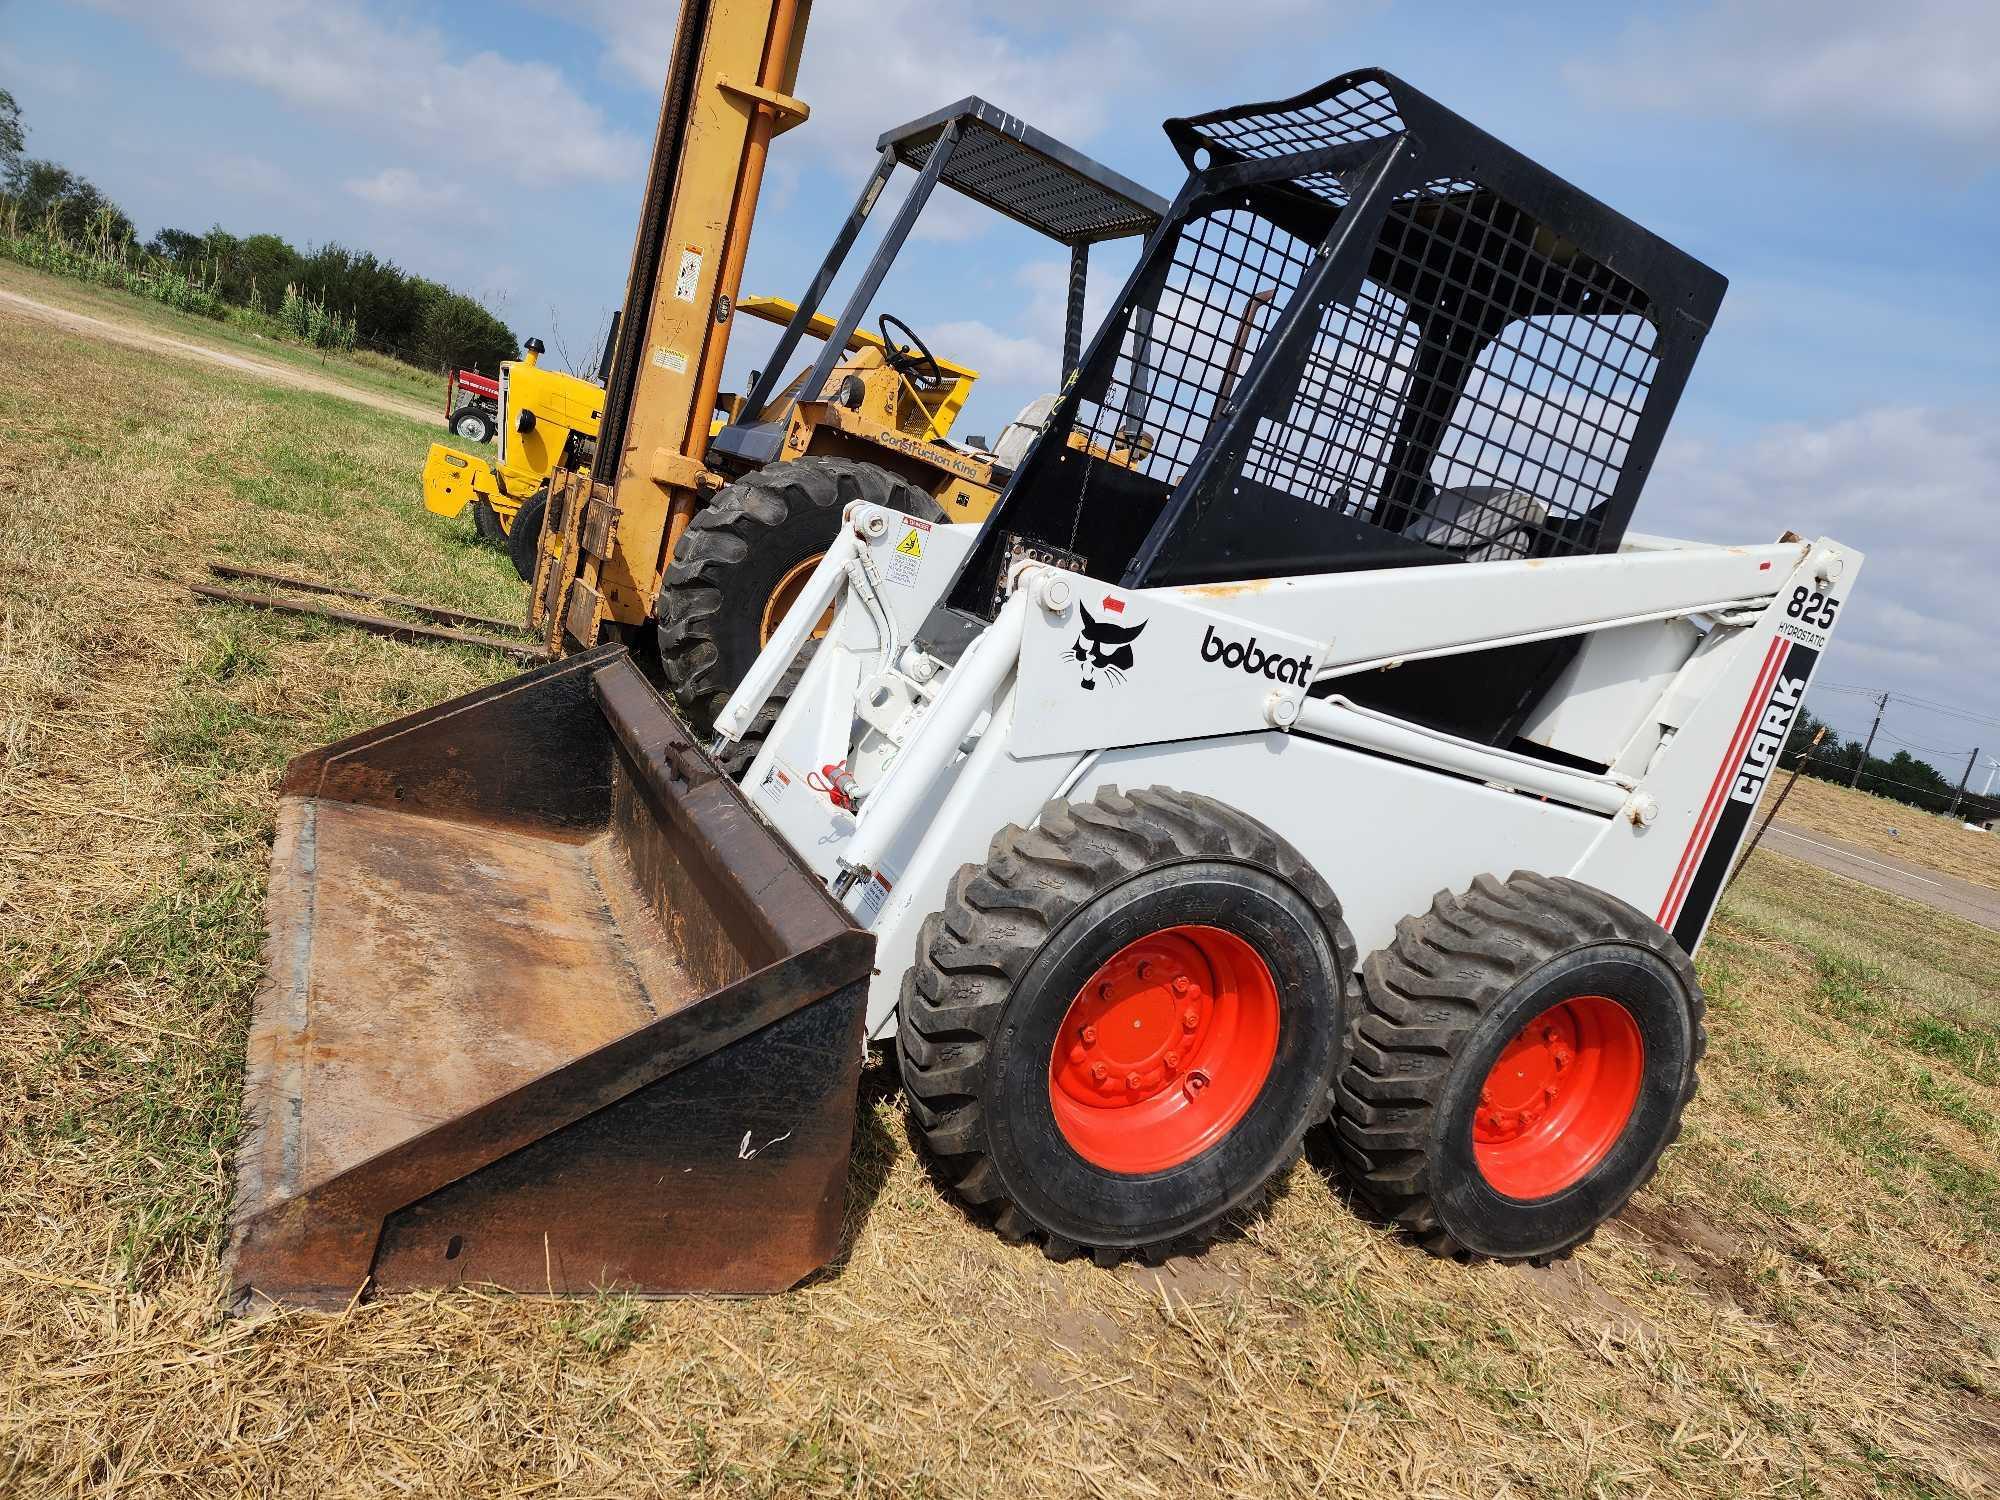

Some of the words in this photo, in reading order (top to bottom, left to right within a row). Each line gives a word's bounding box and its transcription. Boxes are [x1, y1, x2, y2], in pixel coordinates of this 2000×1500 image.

[881, 431, 950, 466] Construction
[952, 459, 977, 479] King
[1786, 585, 1840, 630] 825
[1200, 624, 1313, 688] bobcat
[1778, 621, 1826, 648] HYDROSTATIC
[1729, 673, 1806, 805] CLARK
